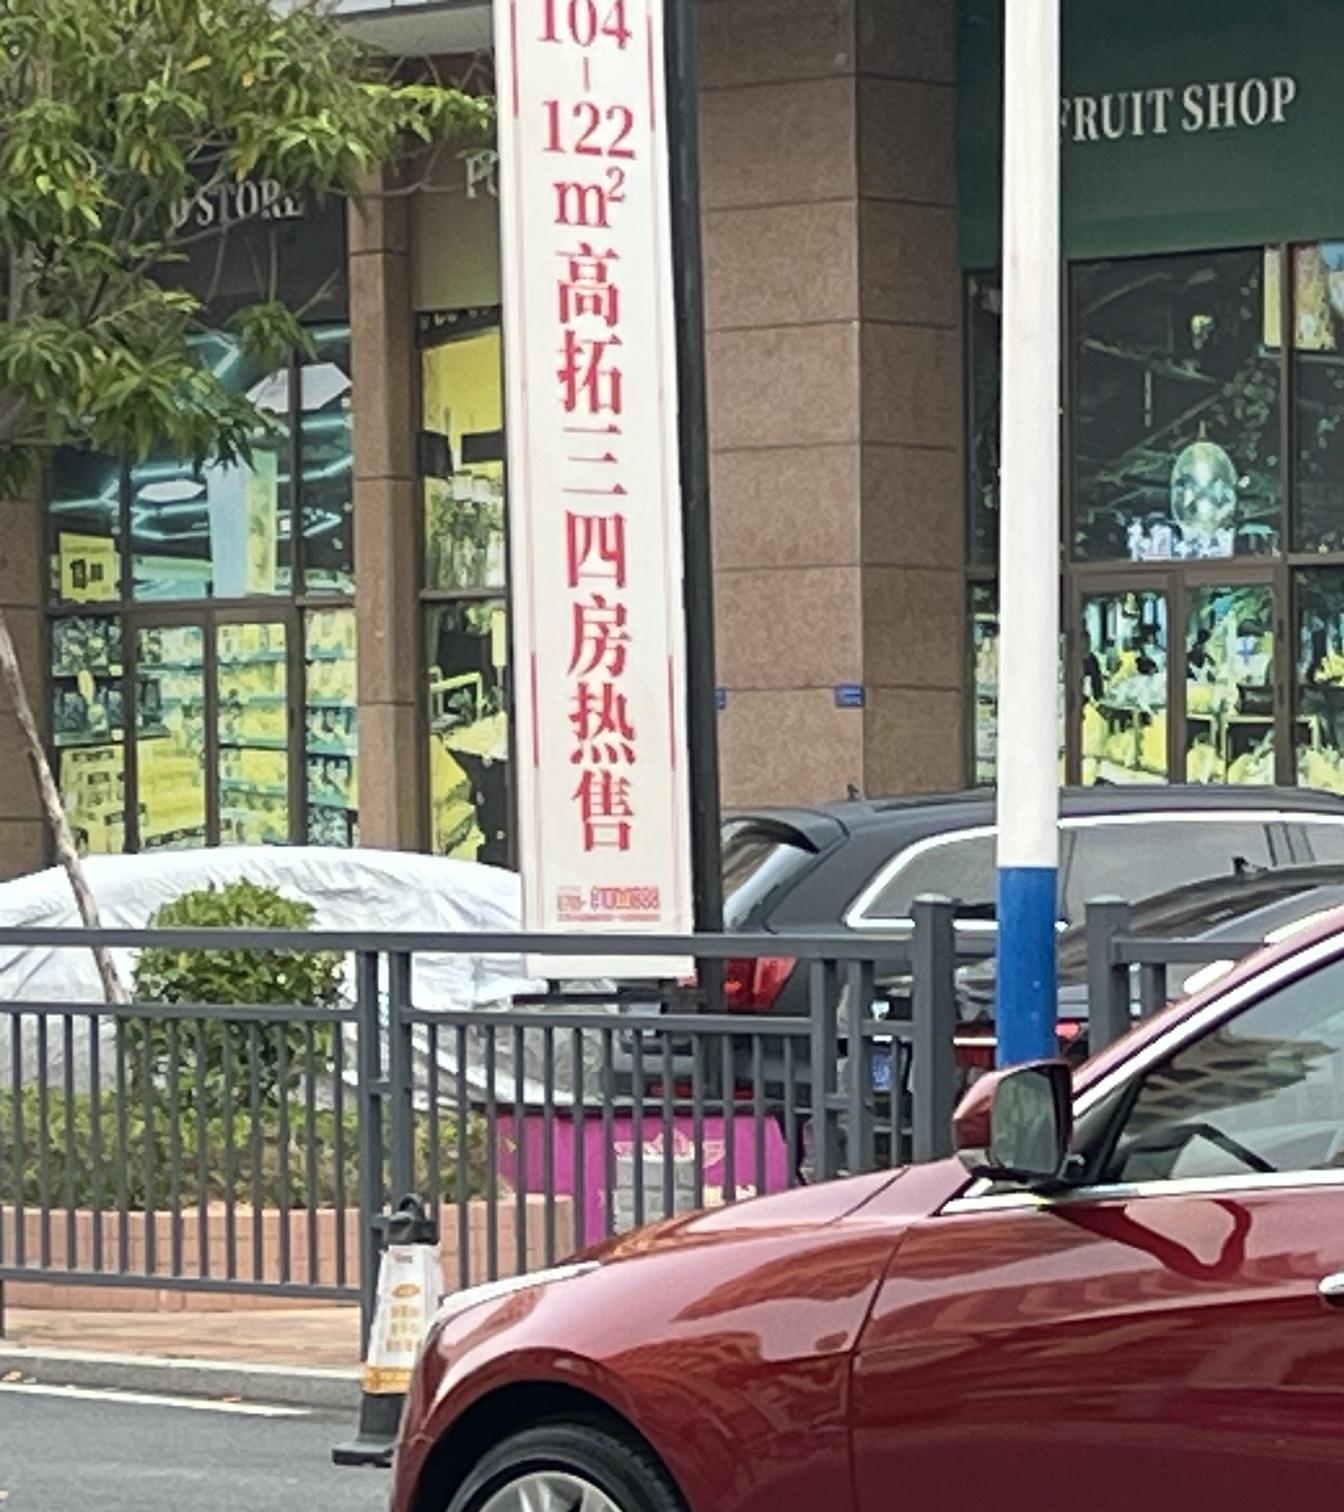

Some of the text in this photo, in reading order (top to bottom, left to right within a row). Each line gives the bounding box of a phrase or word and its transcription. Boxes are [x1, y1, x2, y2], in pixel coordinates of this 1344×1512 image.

[541, 100, 635, 160] 122
[1181, 76, 1296, 132] SHOP
[555, 242, 637, 852] 高拓三四房热售
